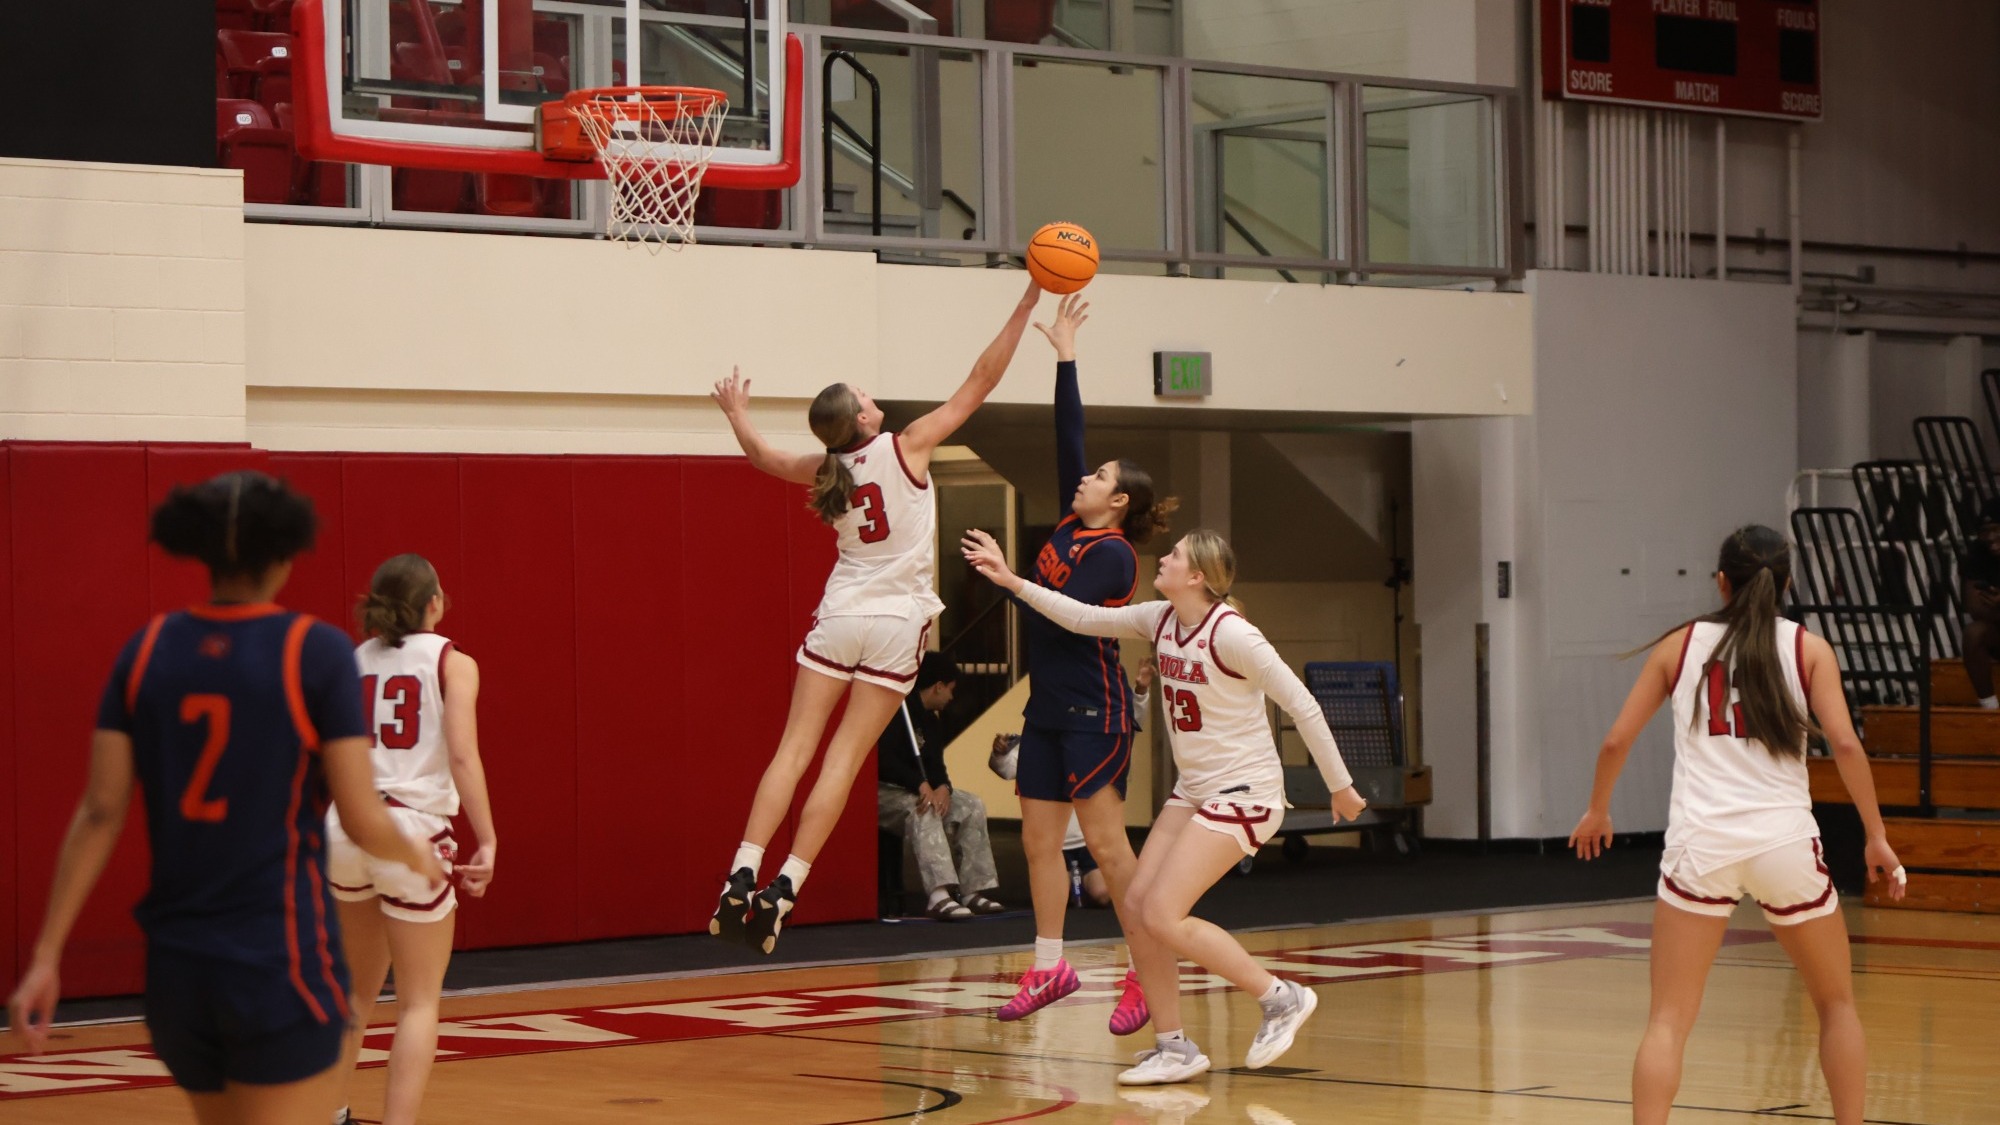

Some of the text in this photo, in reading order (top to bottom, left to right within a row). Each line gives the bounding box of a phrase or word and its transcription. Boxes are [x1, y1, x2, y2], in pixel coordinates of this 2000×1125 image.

[1652, 0, 1739, 21] PLAYER FOUL
[1777, 8, 1816, 30] FOULS
[1570, 70, 1613, 93] SCORE
[1675, 81, 1719, 103] MATCH
[1782, 92, 1820, 114] SCORE
[1057, 231, 1091, 249] NCAA
[1170, 356, 1203, 390] EXIT
[850, 481, 890, 544] 3
[361, 674, 422, 750] 13
[1164, 684, 1203, 733] 23
[180, 694, 231, 822] 2
